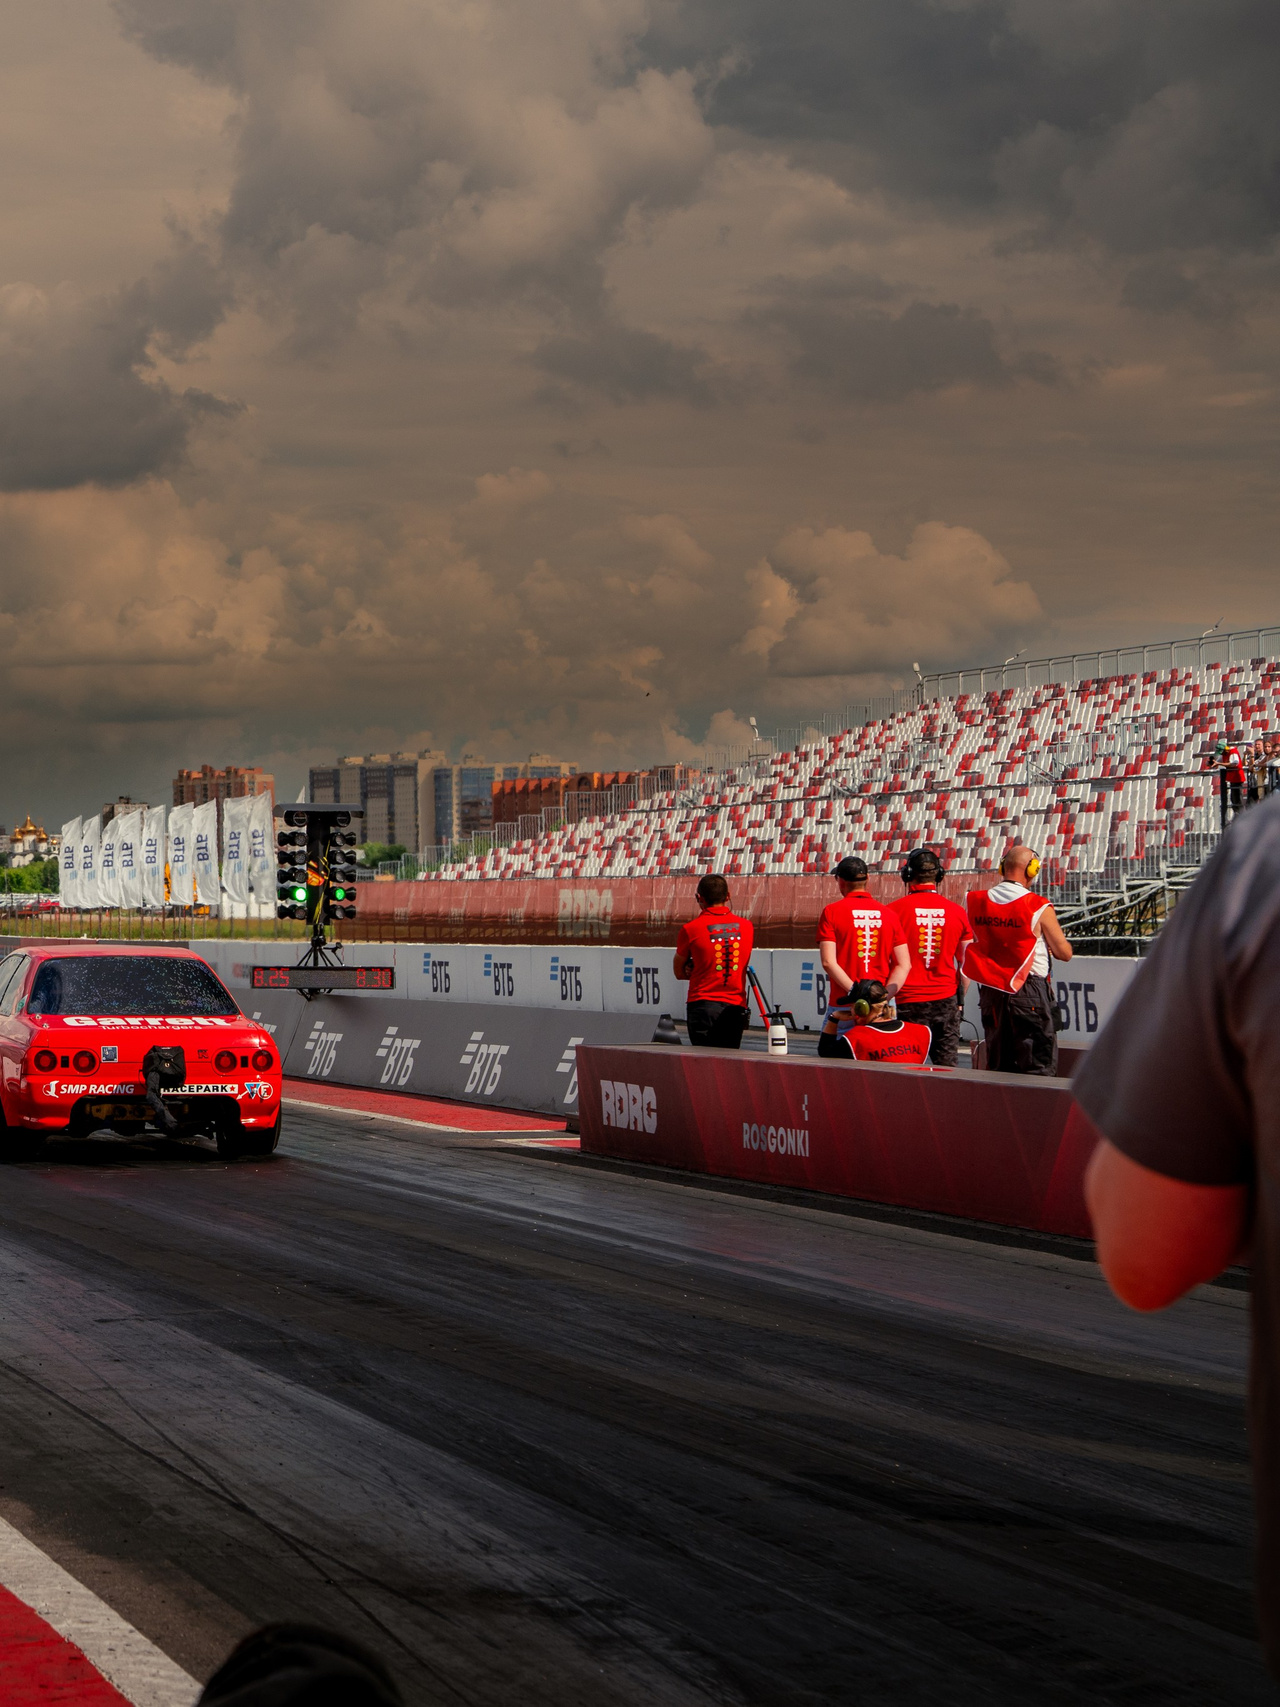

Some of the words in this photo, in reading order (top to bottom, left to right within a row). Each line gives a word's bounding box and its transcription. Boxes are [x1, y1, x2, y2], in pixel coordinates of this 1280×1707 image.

[974, 916, 1022, 928] MARSHAL
[254, 968, 290, 988] 8.25
[356, 968, 392, 988] 8.30
[431, 960, 450, 993] ВТБ
[493, 962, 514, 997] ВТБ
[560, 965, 582, 1001] ВТБ
[635, 967, 660, 1004] ВТБ
[63, 1016, 231, 1027] Garrett
[1057, 981, 1098, 1033] ВТБ
[307, 1032, 344, 1076] ВТБ
[380, 1038, 421, 1086] ВТБ
[464, 1044, 510, 1095] ВТБ
[868, 1044, 920, 1060] MARSHAL
[60, 1084, 87, 1094] SMP
[88, 1084, 135, 1094] RACING
[600, 1080, 658, 1134] RDRC
[742, 1122, 810, 1157] ROSGONKI
